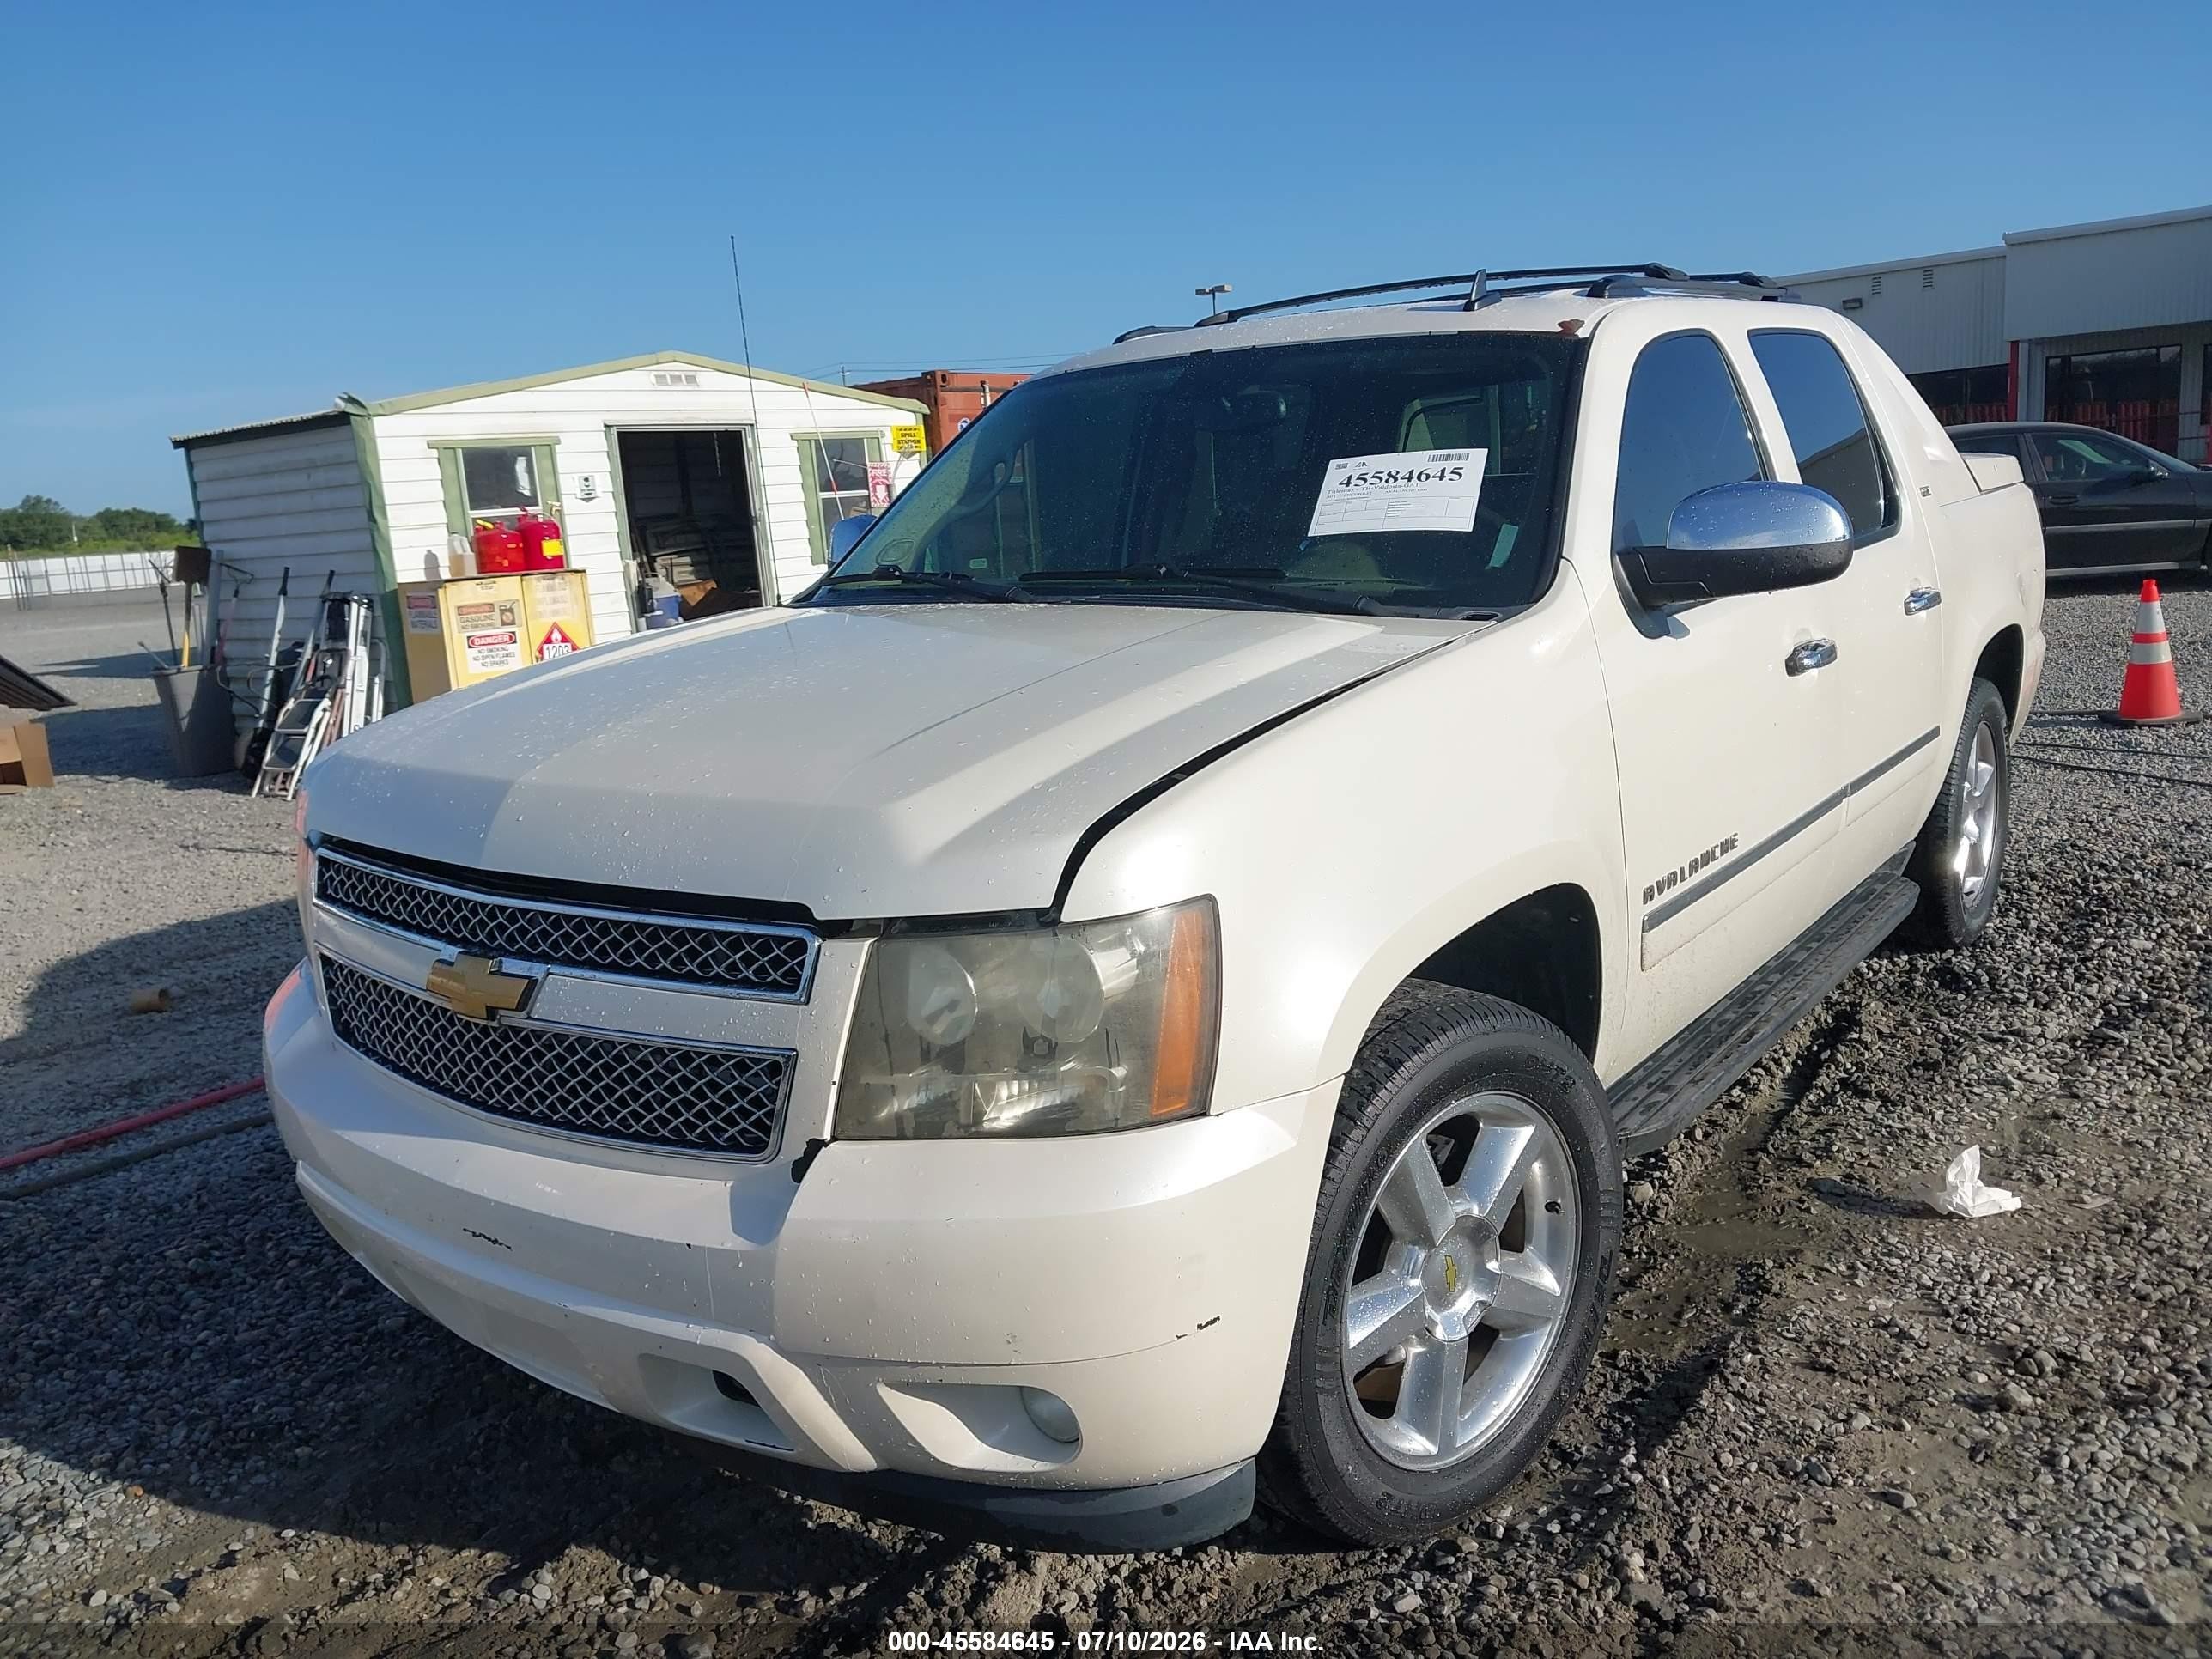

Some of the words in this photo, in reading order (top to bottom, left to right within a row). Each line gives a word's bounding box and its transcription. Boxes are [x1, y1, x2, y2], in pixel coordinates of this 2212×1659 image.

[1338, 466, 1464, 488] 45584645
[459, 613, 495, 624] GASOLINE
[473, 635, 510, 647] DANGER
[495, 651, 516, 659] FLAMES
[545, 644, 569, 659] 1203
[1642, 832, 1739, 905] AVALANCHE
